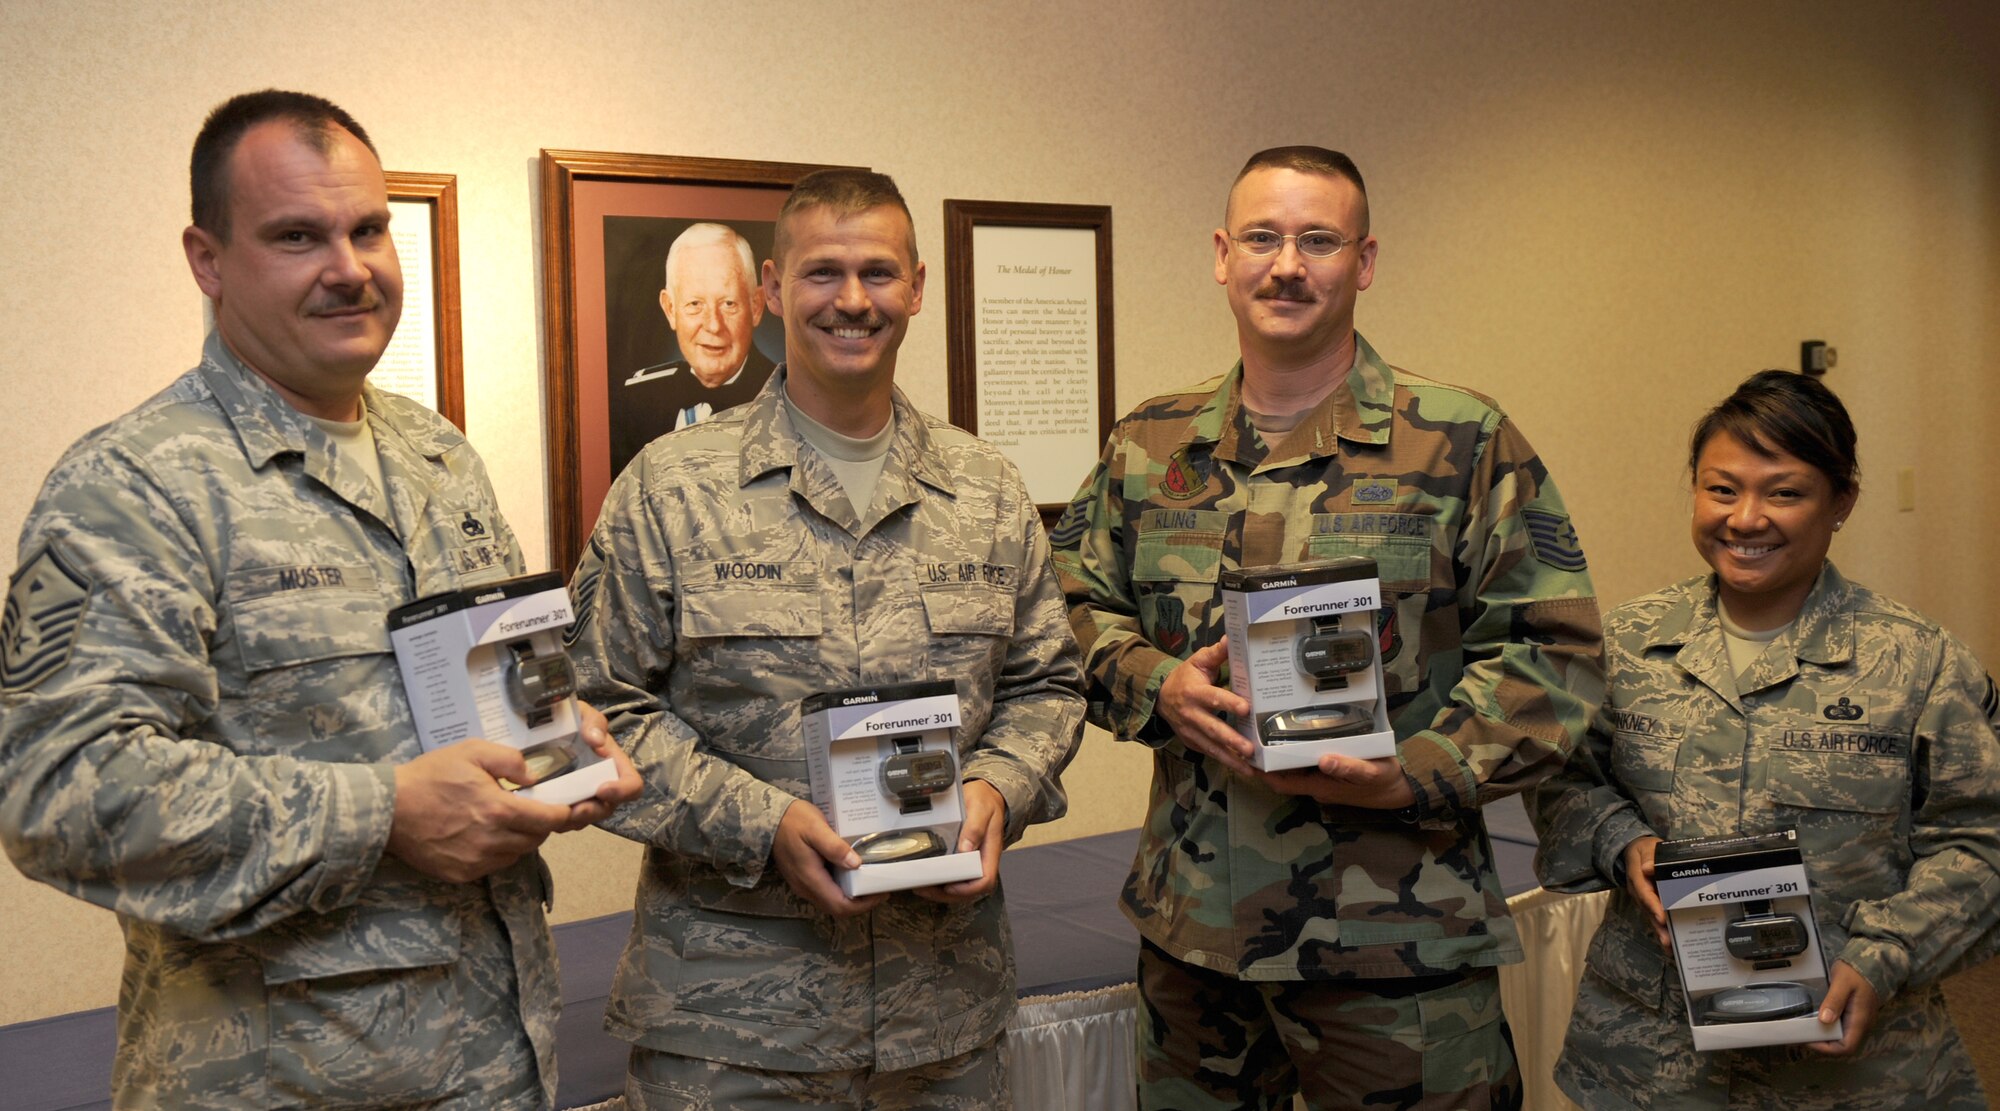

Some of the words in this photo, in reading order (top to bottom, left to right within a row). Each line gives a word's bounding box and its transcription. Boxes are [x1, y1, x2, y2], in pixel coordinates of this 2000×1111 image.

[997, 265, 1011, 274] The
[1013, 265, 1037, 274] Medal
[1039, 266, 1047, 276] of
[1049, 266, 1072, 275] Honor
[1154, 511, 1197, 530] KLING
[1318, 514, 1345, 533] U.S.
[1350, 514, 1374, 533] AIR
[1379, 514, 1426, 535] FORCE
[279, 567, 345, 591] MUSTER
[714, 562, 782, 581] WOODIN
[927, 563, 950, 582] U.S.
[958, 563, 976, 582] AIR
[1261, 579, 1298, 590] GARMIN
[1284, 600, 1349, 616] Forerunner
[1353, 596, 1373, 608] 301
[498, 614, 550, 634] Forerunner
[552, 607, 568, 622] 301
[843, 694, 878, 706] GARMIN
[866, 716, 930, 732] Forerunner
[934, 713, 953, 725] 301
[1616, 712, 1657, 732] NKNEY
[1783, 731, 1814, 749] U.S.
[1819, 732, 1845, 751] AIR
[1848, 734, 1898, 753] FORCE
[1690, 834, 1762, 848] Forerunner
[1671, 867, 1710, 878] GARMIN
[1698, 886, 1771, 903] Forerunner
[1776, 881, 1799, 894] 301
